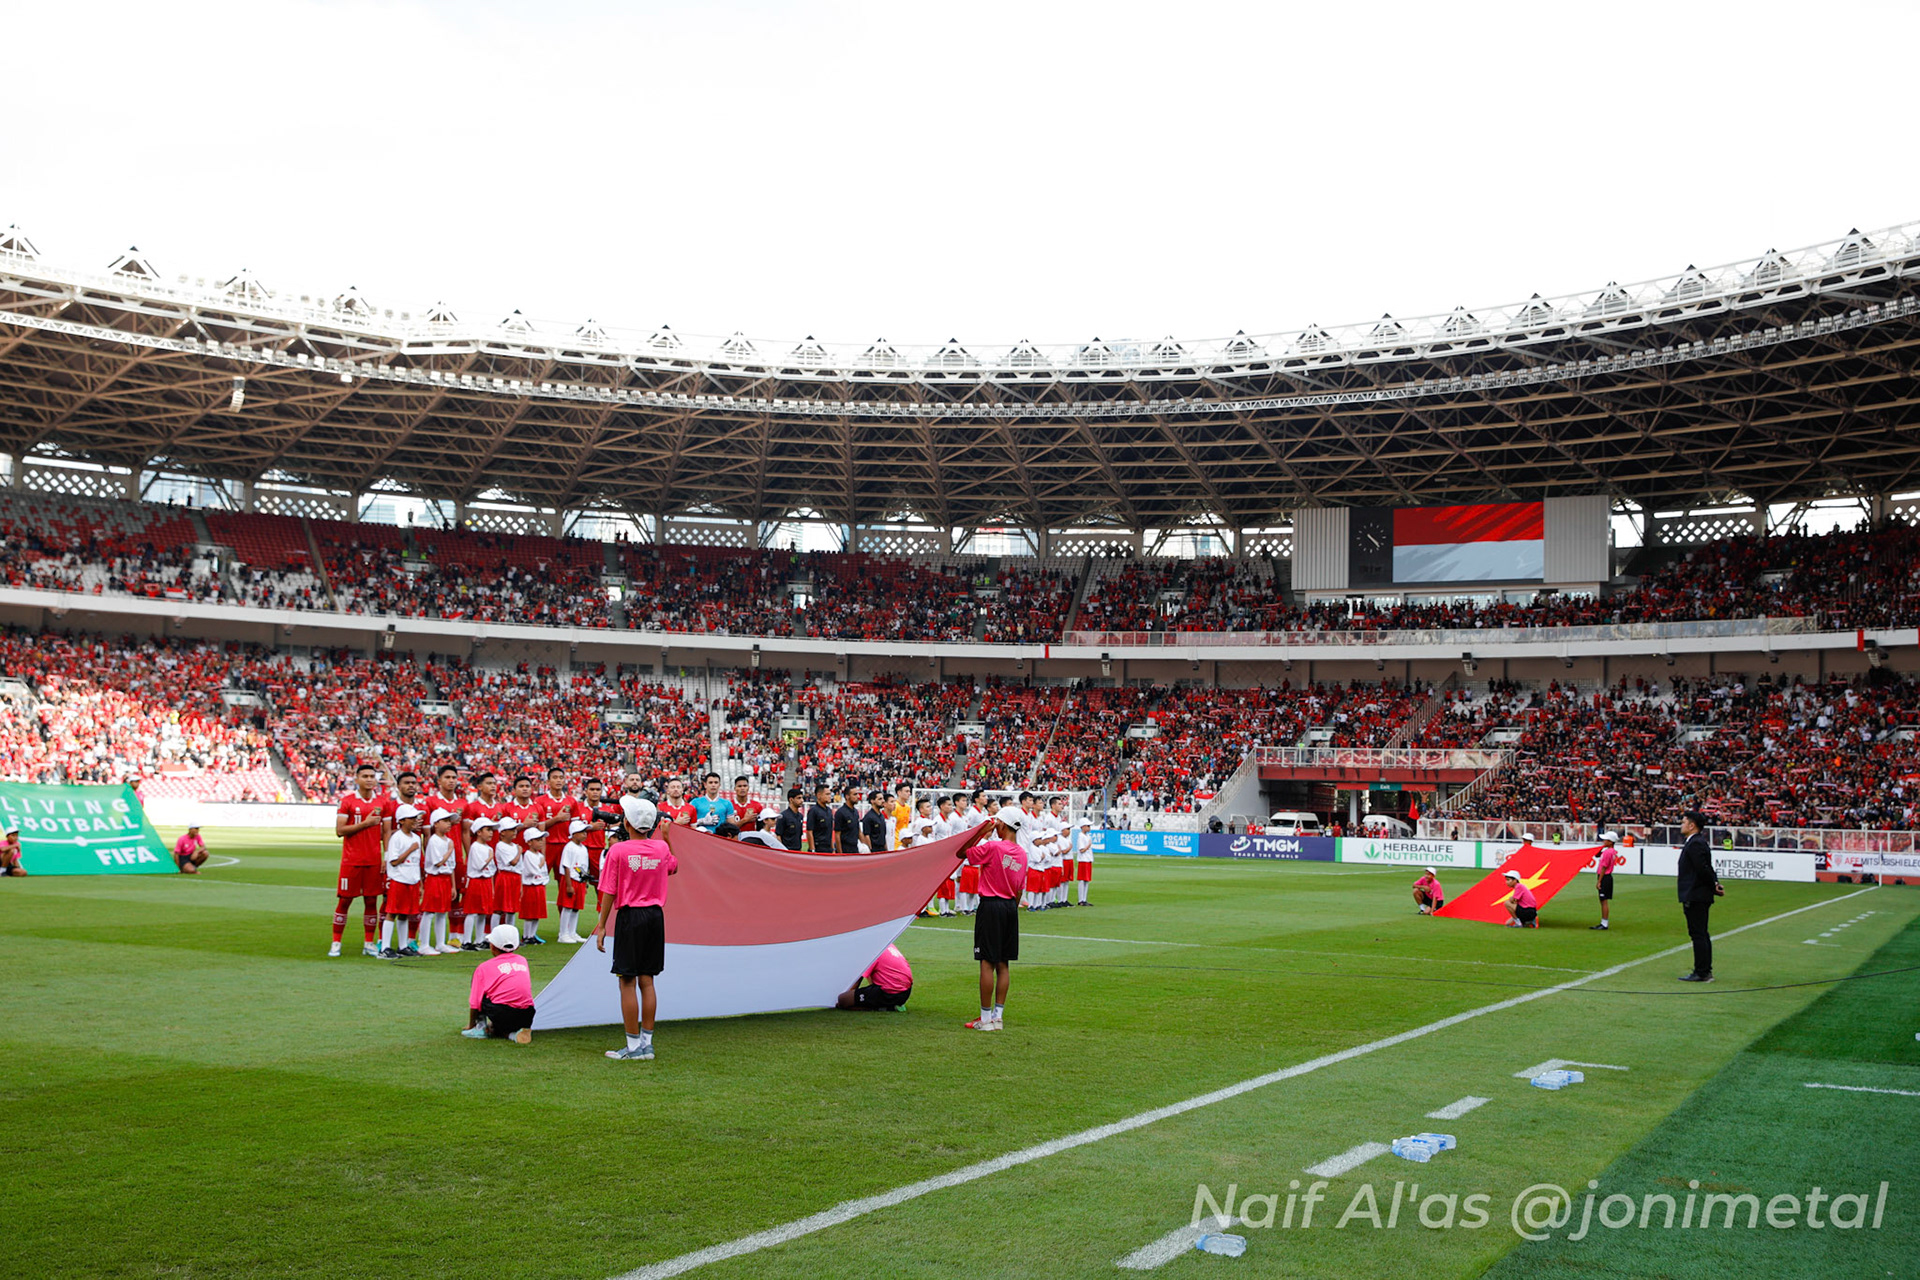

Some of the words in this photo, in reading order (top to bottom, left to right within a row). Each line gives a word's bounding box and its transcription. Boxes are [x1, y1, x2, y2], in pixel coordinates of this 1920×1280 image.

[1, 796, 130, 815] LIVING
[1120, 833, 1148, 841] POCARI
[1252, 838, 1300, 853] TMGM
[1383, 843, 1454, 853] HERBALIFE
[95, 846, 159, 866] FIFA
[1383, 852, 1454, 862] NUTRITION
[1715, 859, 1774, 870] MITSUBISHI
[1716, 868, 1766, 879] ELECTRIC
